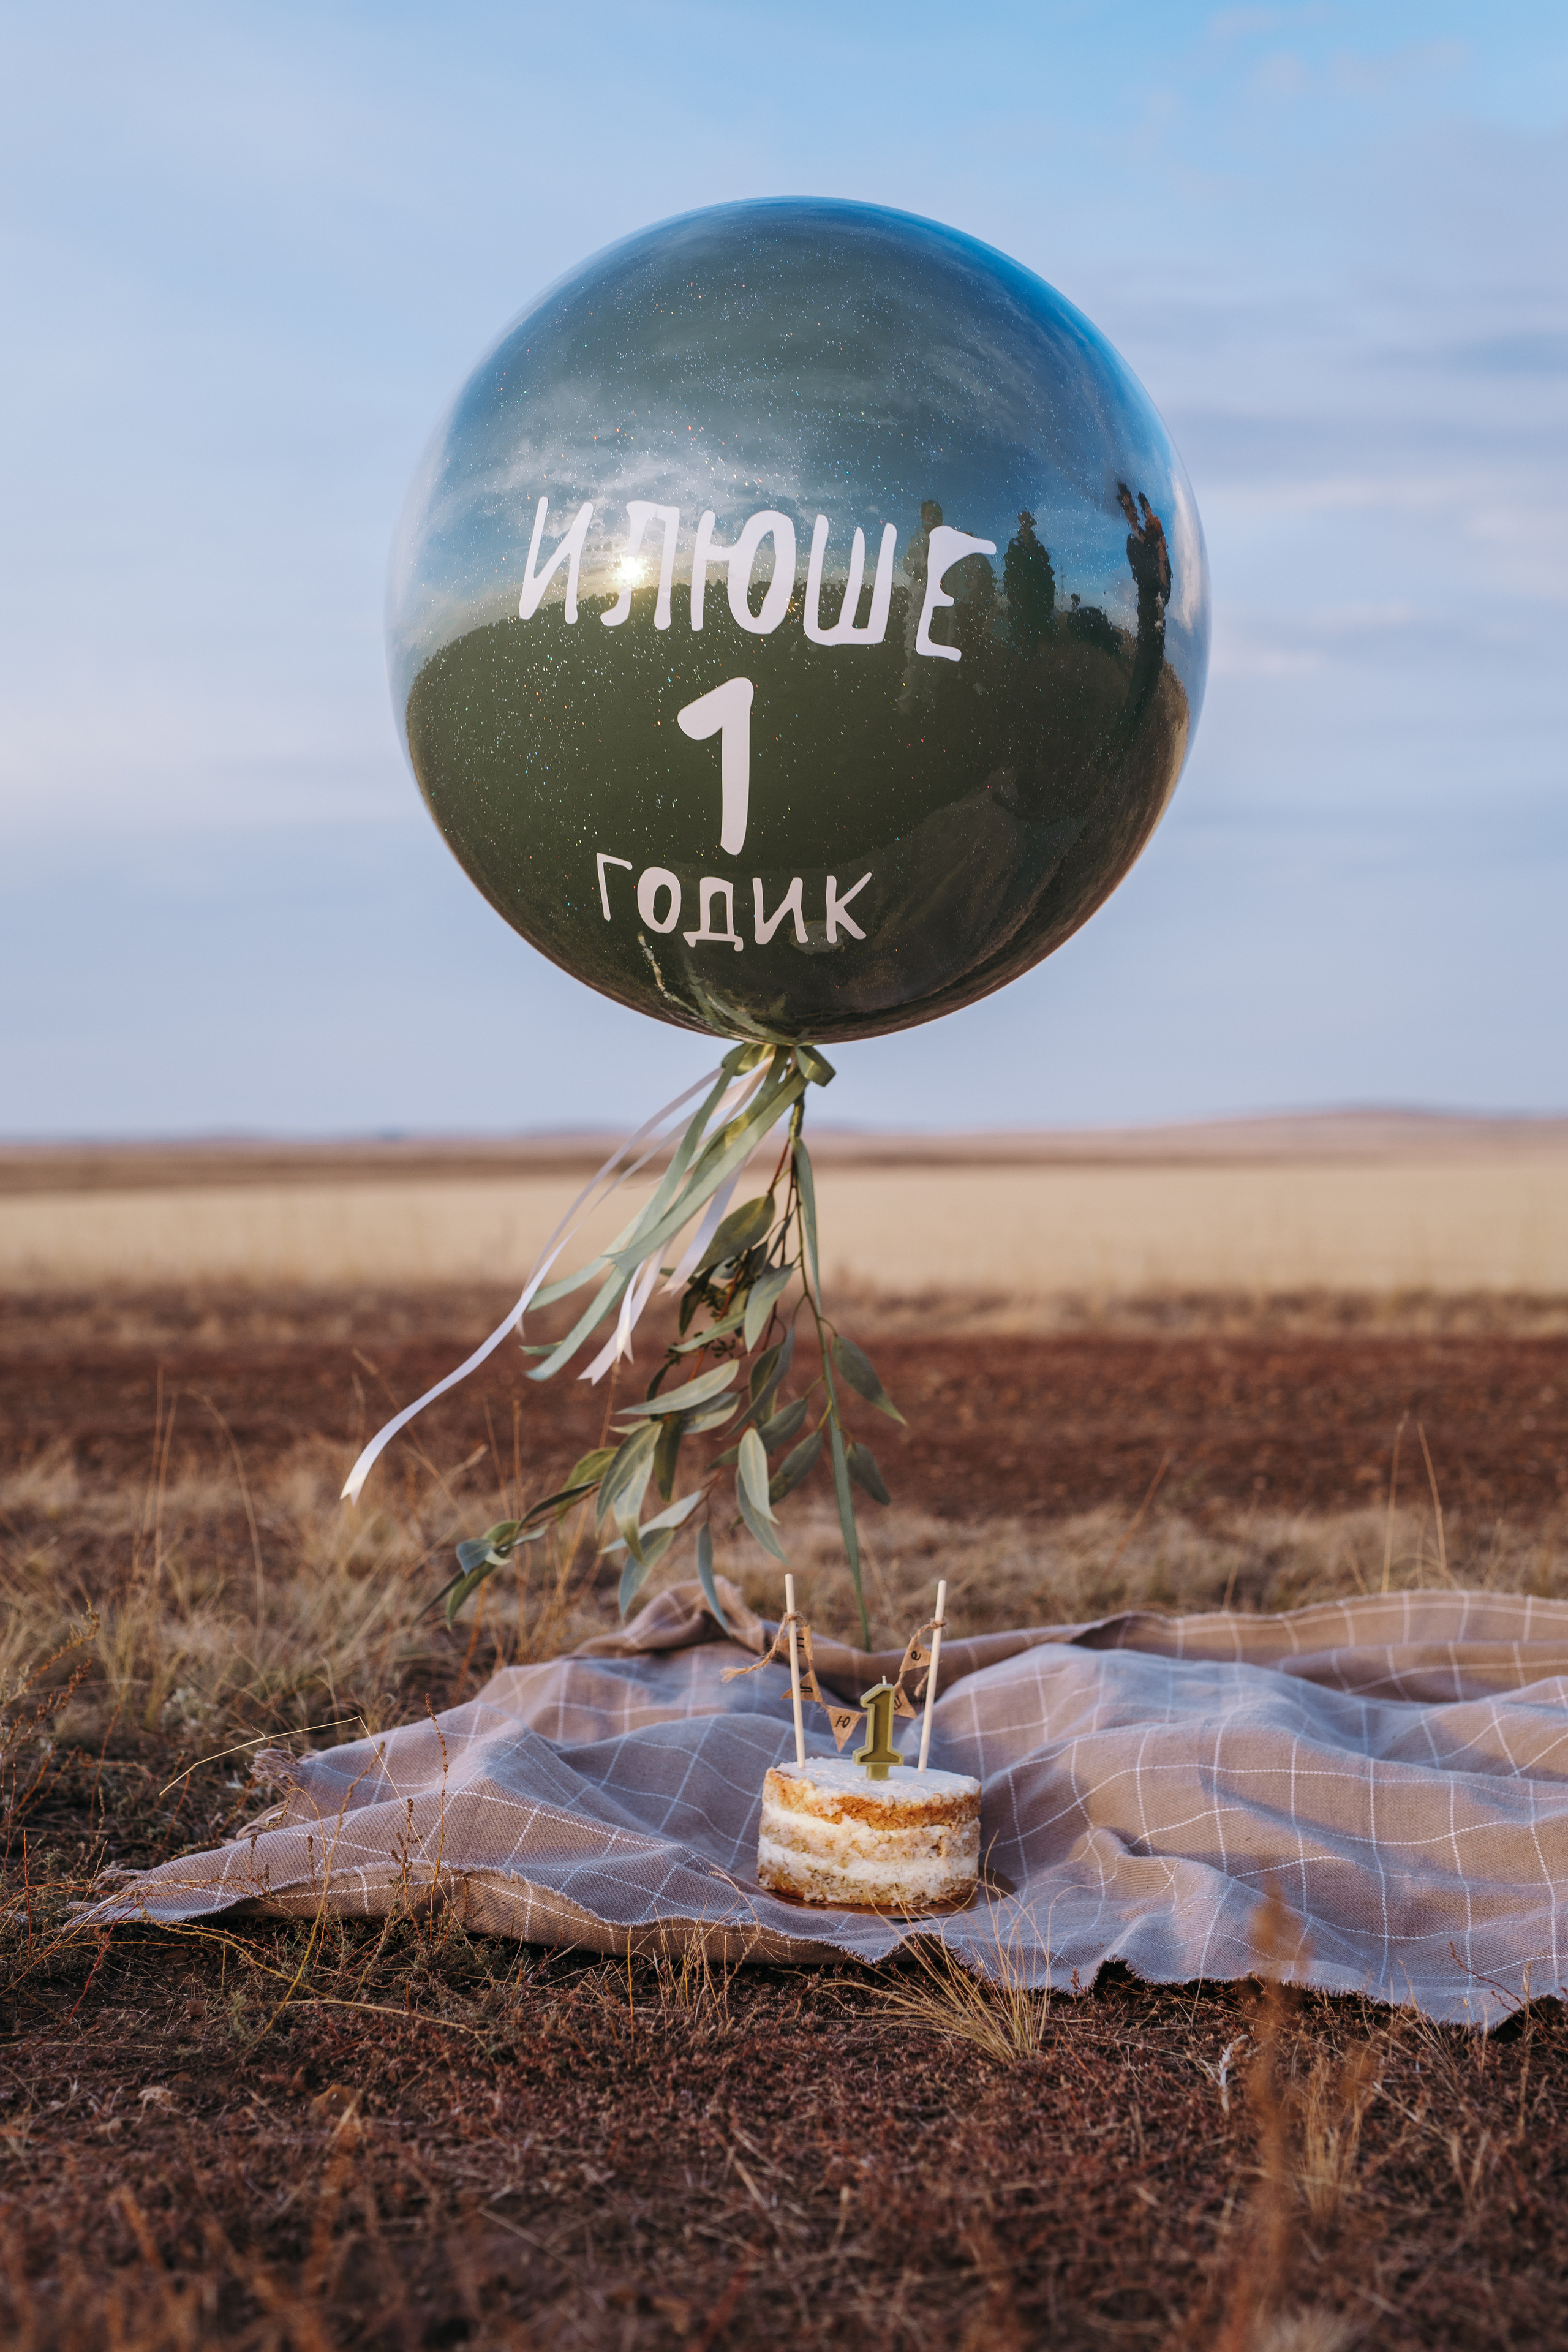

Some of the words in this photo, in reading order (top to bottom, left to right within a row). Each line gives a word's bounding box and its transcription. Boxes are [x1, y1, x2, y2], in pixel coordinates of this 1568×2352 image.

[518, 496, 997, 662] ИЛЮШЕ
[677, 676, 754, 856] 1
[596, 853, 872, 952] ГОДИК
[853, 1683, 904, 1766] 1
